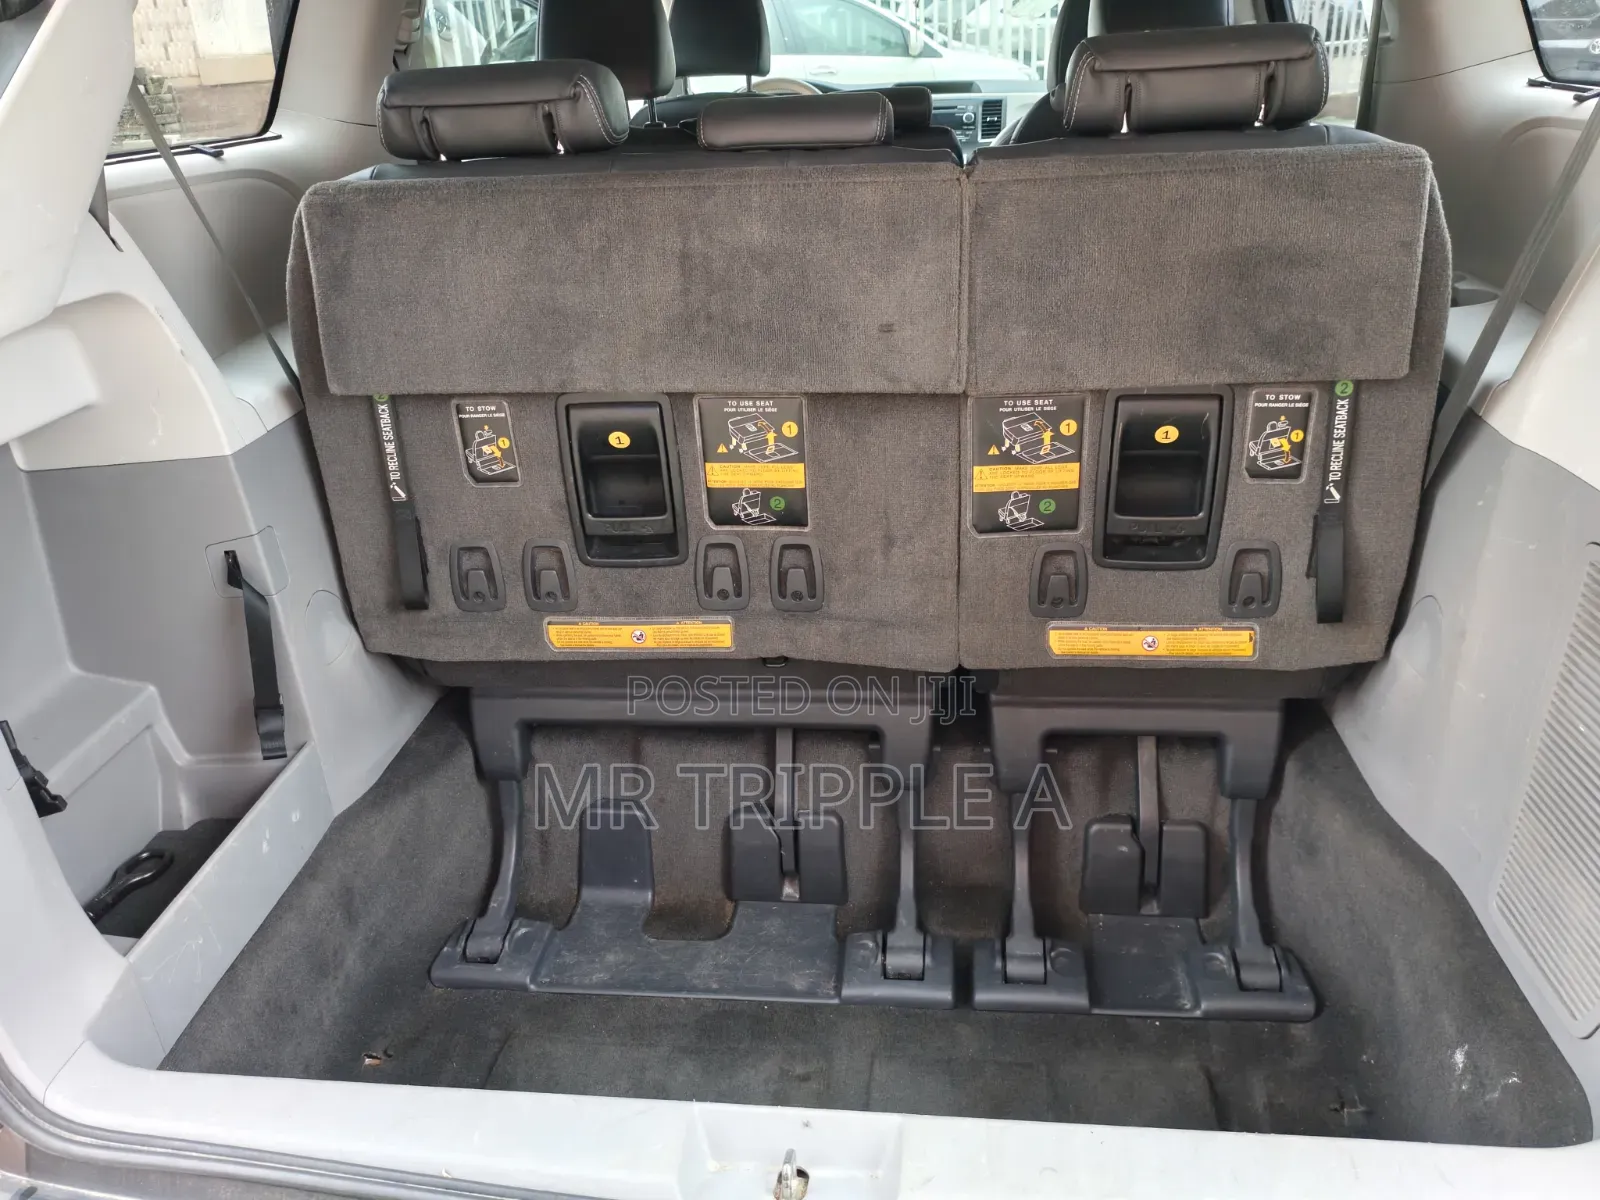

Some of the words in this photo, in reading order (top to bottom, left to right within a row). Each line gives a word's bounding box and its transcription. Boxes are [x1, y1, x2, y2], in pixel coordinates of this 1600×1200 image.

[377, 403, 394, 441] SEATBACK
[1333, 398, 1350, 439] SEATBACK
[614, 436, 625, 445] 1
[1161, 430, 1171, 440] 1
[384, 441, 400, 471] RECLINE
[1330, 439, 1346, 471] RECLINE
[389, 471, 401, 481] TO
[1328, 471, 1342, 482] TO
